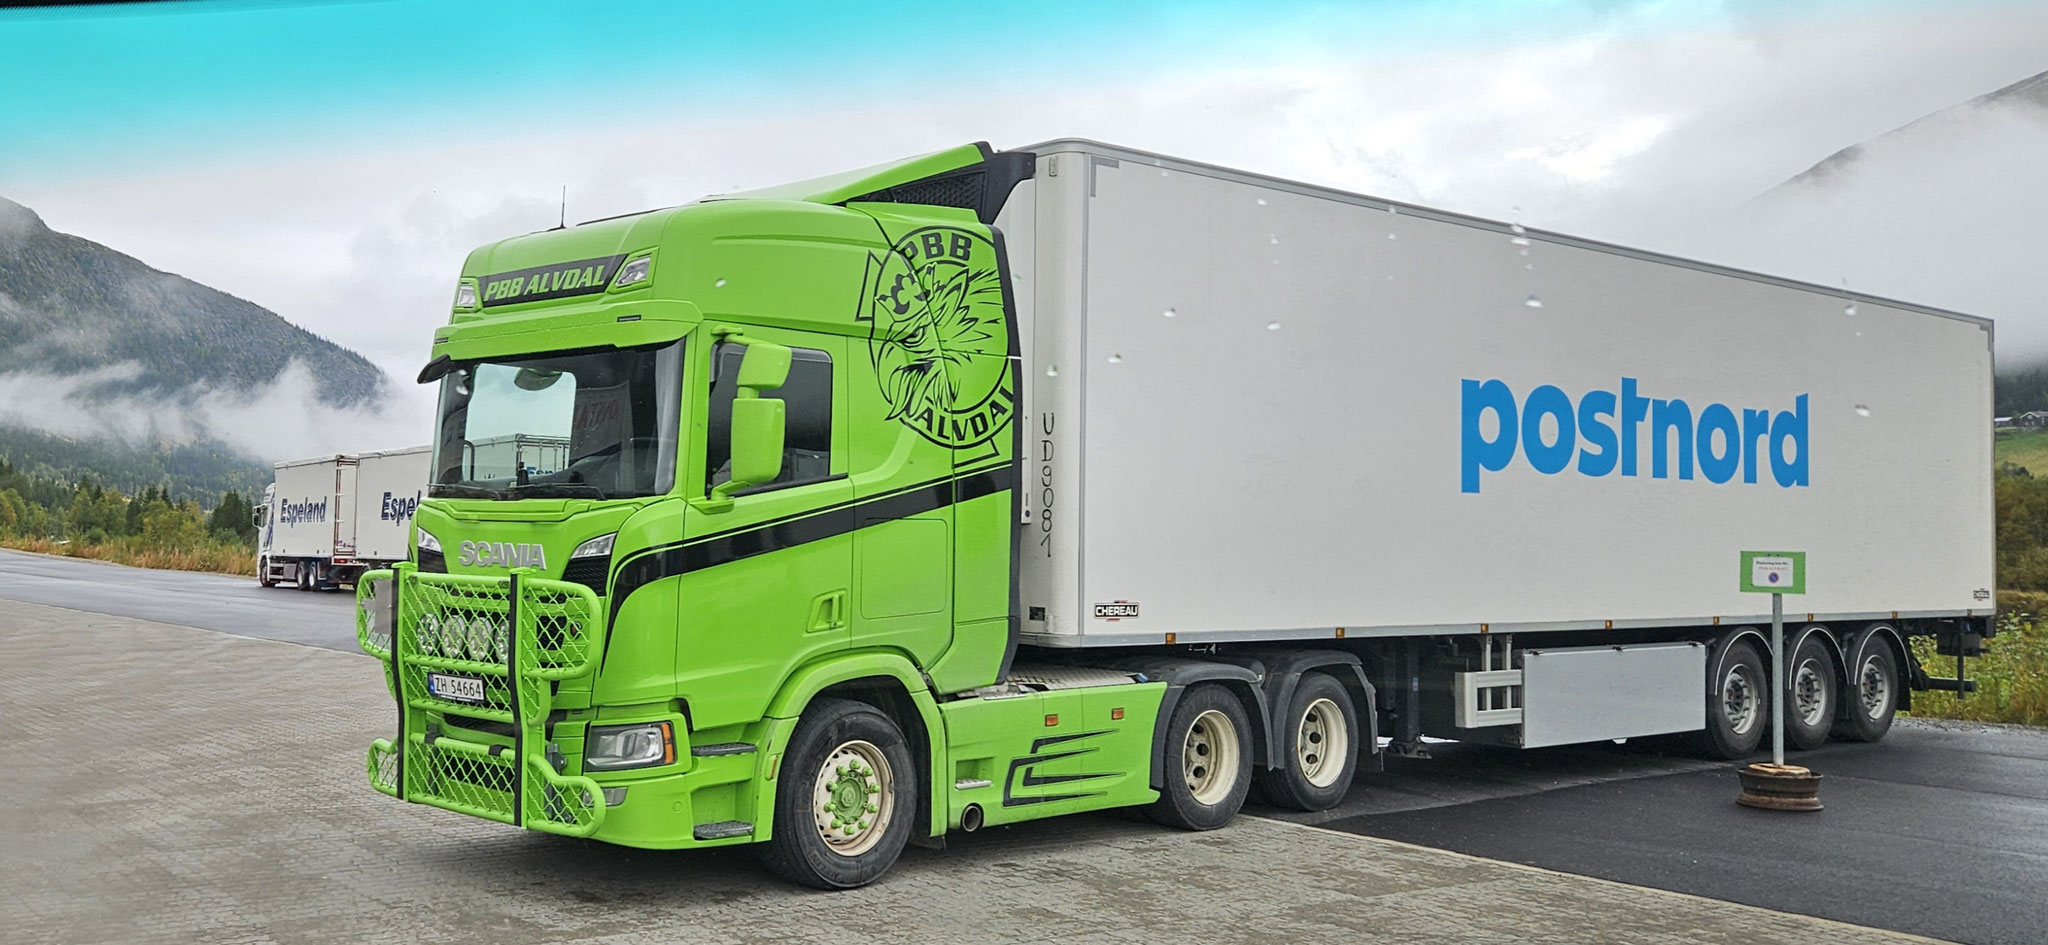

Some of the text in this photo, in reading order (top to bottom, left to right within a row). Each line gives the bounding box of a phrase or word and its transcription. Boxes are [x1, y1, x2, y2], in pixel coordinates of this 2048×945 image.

[899, 232, 972, 261] PBB
[483, 265, 605, 302] PBB ALVDAL
[1461, 376, 1809, 494] postnord
[280, 496, 327, 528] Espeland
[381, 490, 421, 526] Espel
[458, 540, 547, 570] SCANIA
[1095, 605, 1138, 617] CHEREAU
[435, 677, 482, 698] ZH 54664
